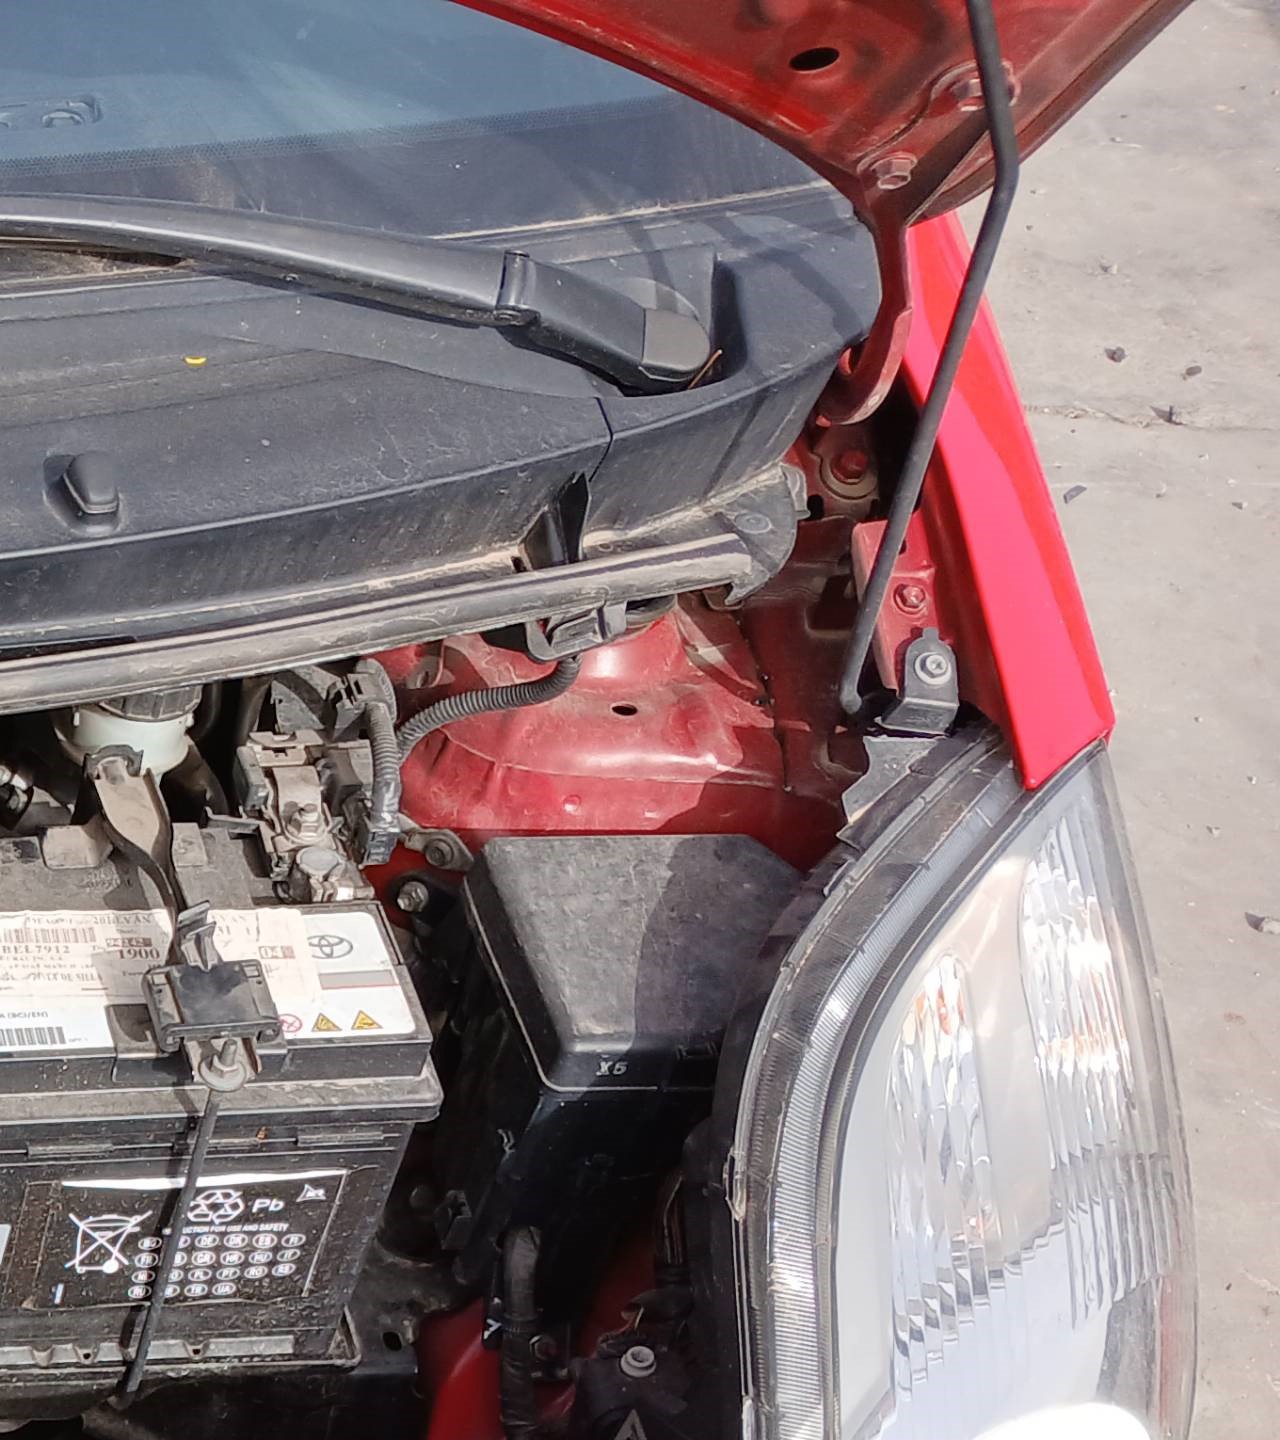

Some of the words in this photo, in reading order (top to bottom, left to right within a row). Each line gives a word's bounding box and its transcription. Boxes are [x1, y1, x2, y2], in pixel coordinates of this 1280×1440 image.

[118, 946, 161, 960] 1900
[252, 1199, 284, 1212] Pb
[258, 1222, 289, 1232] SAFETY
